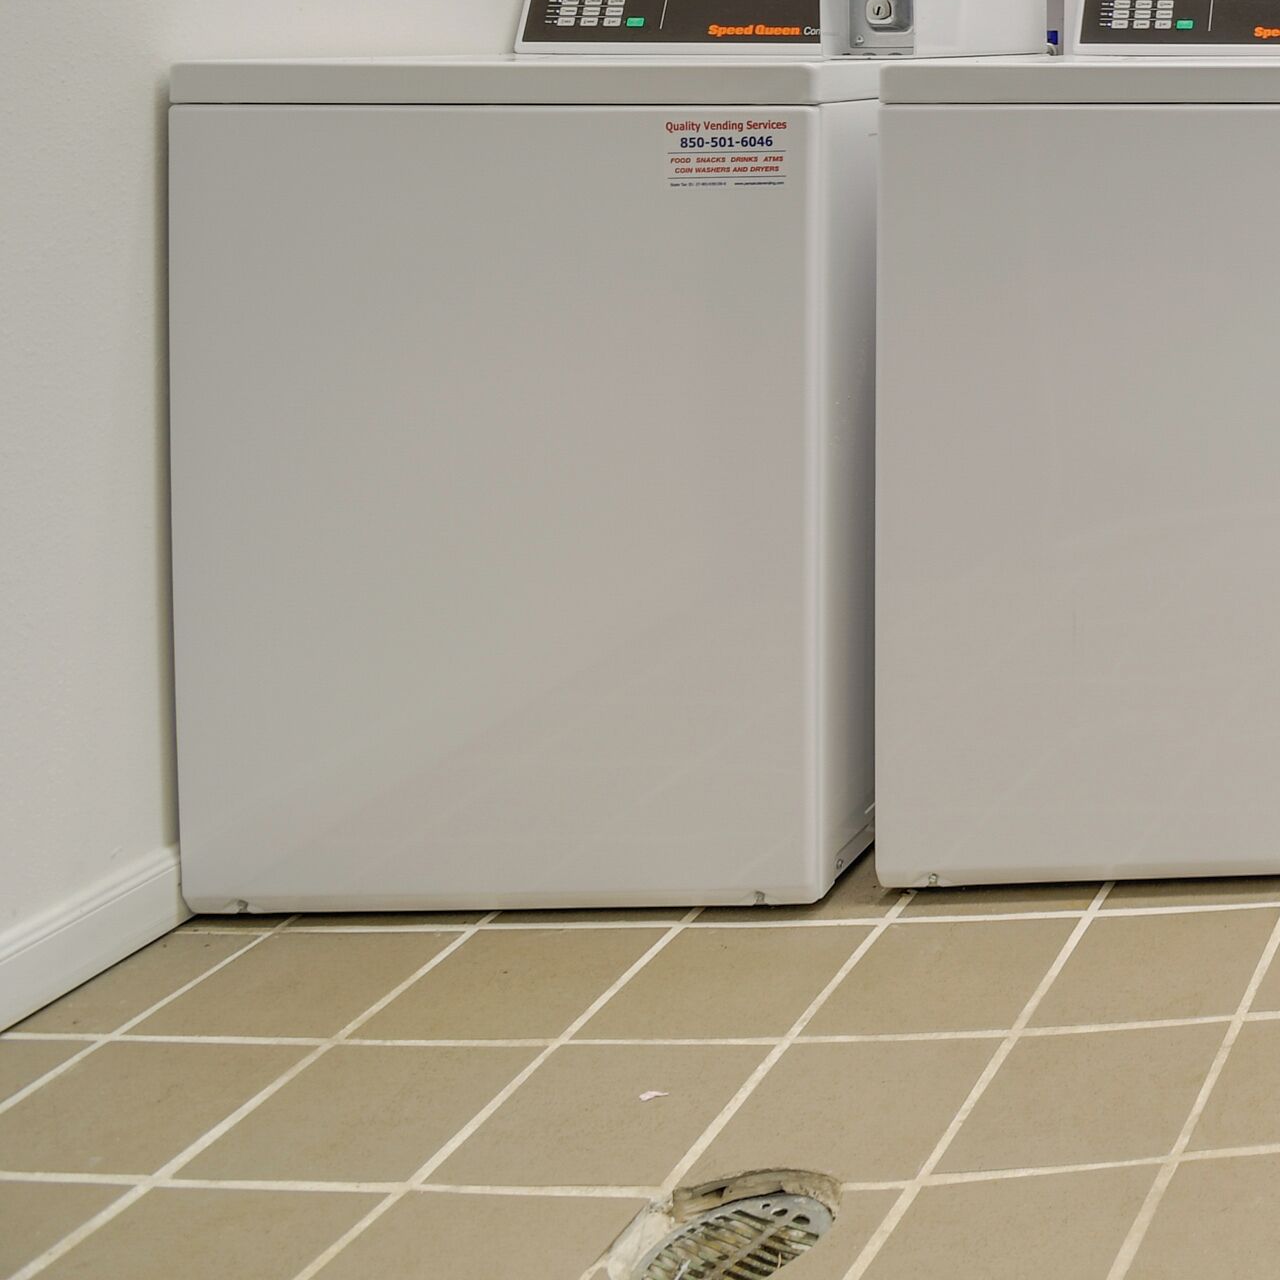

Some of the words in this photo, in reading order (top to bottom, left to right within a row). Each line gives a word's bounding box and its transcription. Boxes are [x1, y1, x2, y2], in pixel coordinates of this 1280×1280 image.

[708, 24, 753, 37] Speed
[754, 24, 800, 36] Queen
[665, 121, 701, 132] Quality
[703, 120, 744, 132] Vending
[746, 120, 787, 130] Services
[680, 136, 773, 148] 850-501-6046
